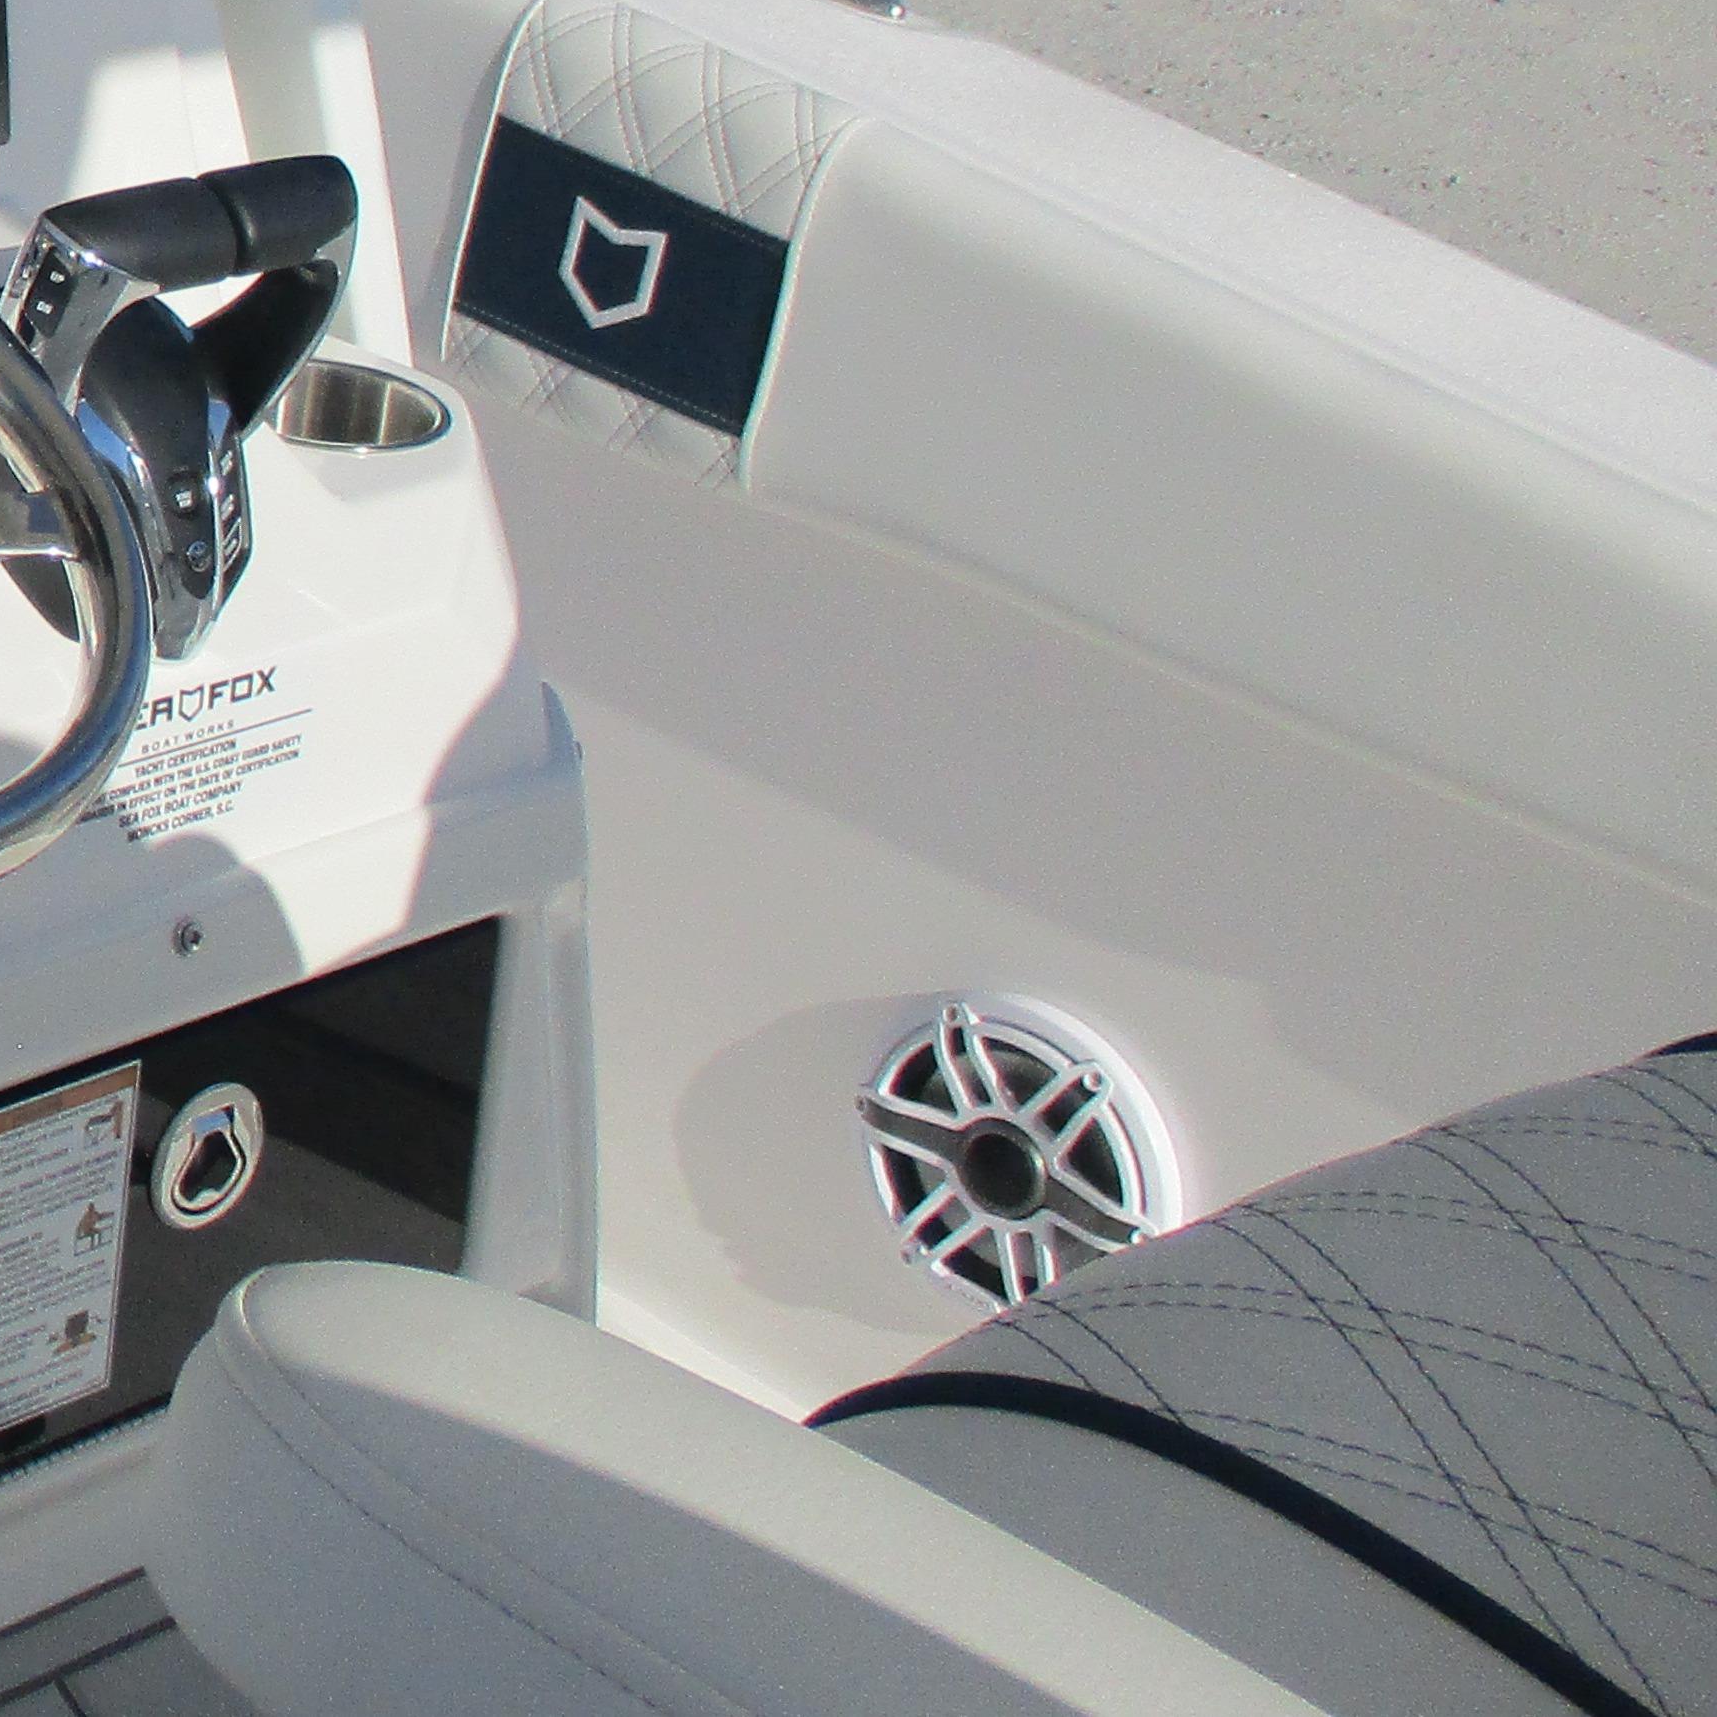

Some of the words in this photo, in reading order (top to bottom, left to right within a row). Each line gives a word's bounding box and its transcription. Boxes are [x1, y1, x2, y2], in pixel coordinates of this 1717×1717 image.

[207, 665, 278, 710] FOX
[141, 736, 181, 755] BOAT
[184, 719, 236, 743] WORKS
[167, 740, 235, 769] CERTIFICATION
[272, 734, 300, 752] SAFETY
[128, 791, 161, 810] EFFECT
[180, 781, 195, 795] THE
[197, 774, 220, 790] DATE
[235, 751, 298, 778] CERTIFICATION
[118, 813, 137, 828] SEA
[141, 806, 160, 821] FOX
[163, 797, 191, 814] BOAT
[193, 782, 241, 806] COMPANY
